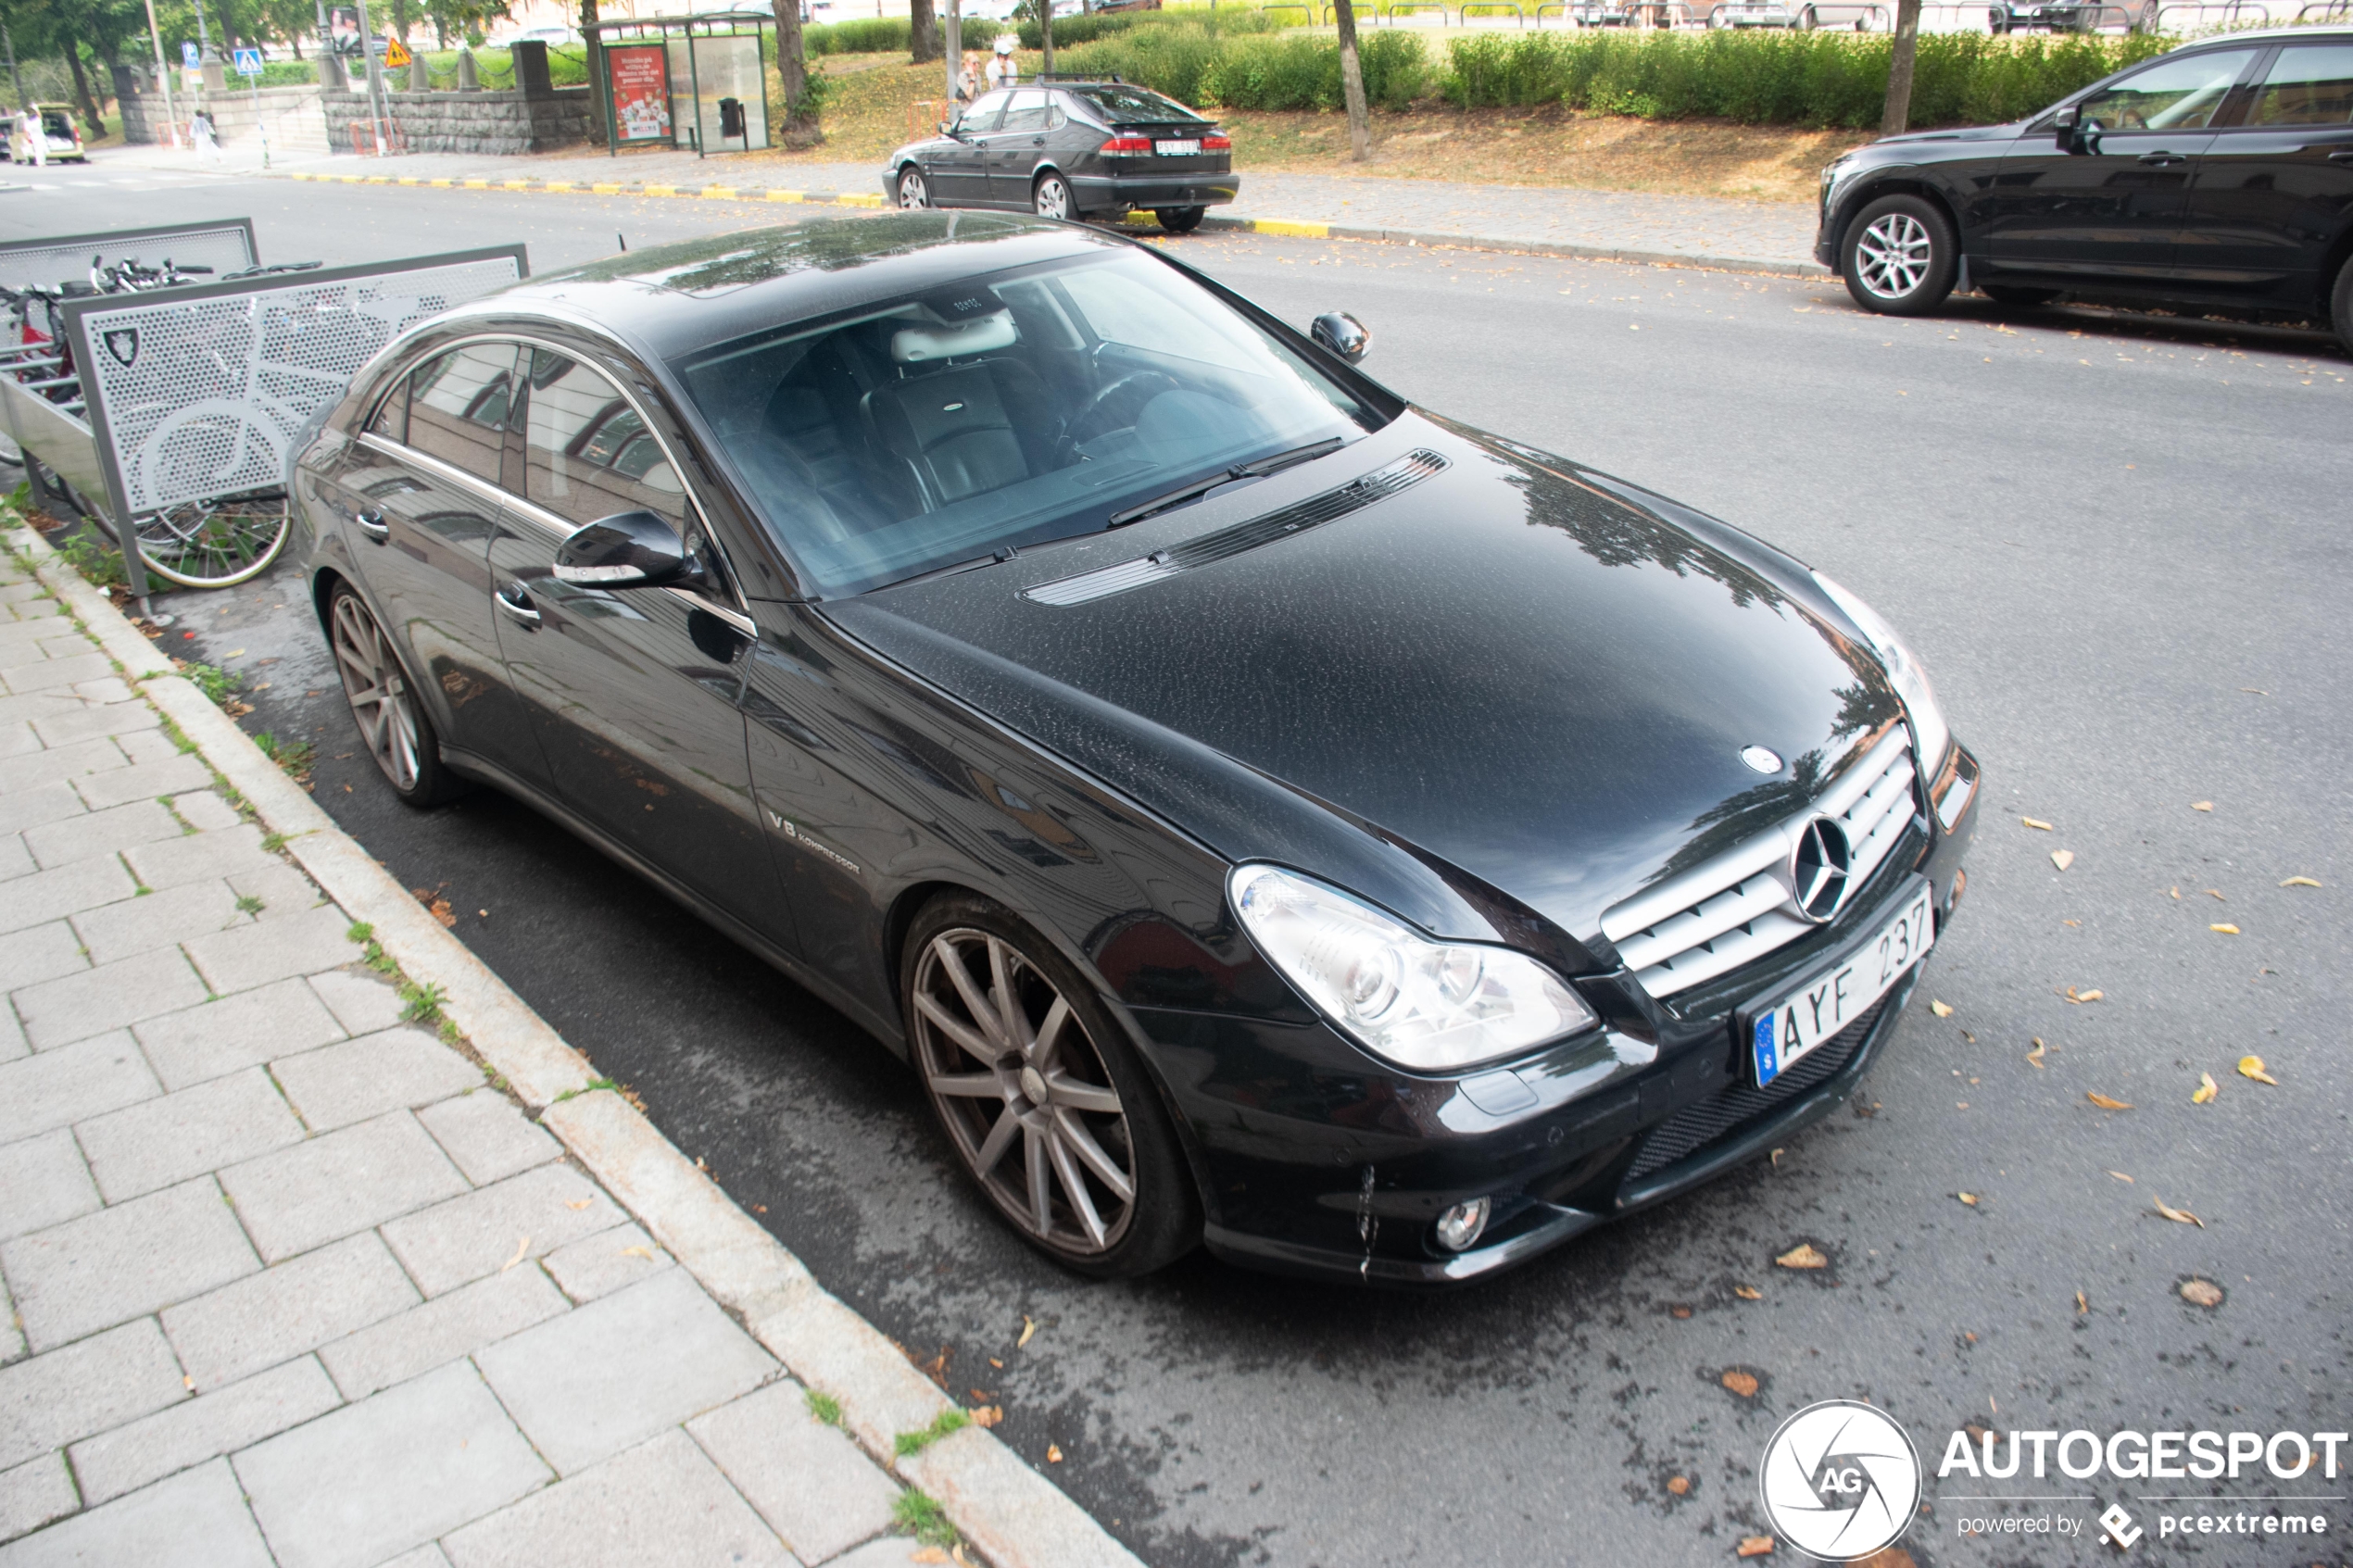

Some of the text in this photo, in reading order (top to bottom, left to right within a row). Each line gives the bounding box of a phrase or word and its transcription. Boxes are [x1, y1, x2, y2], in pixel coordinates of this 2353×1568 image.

[186, 44, 195, 57] P
[1158, 141, 1197, 152] PSY 599
[768, 810, 861, 874] V8 KOMPRESSOR
[1783, 899, 1925, 1058] AYF 237
[1764, 1054, 1772, 1070] S
